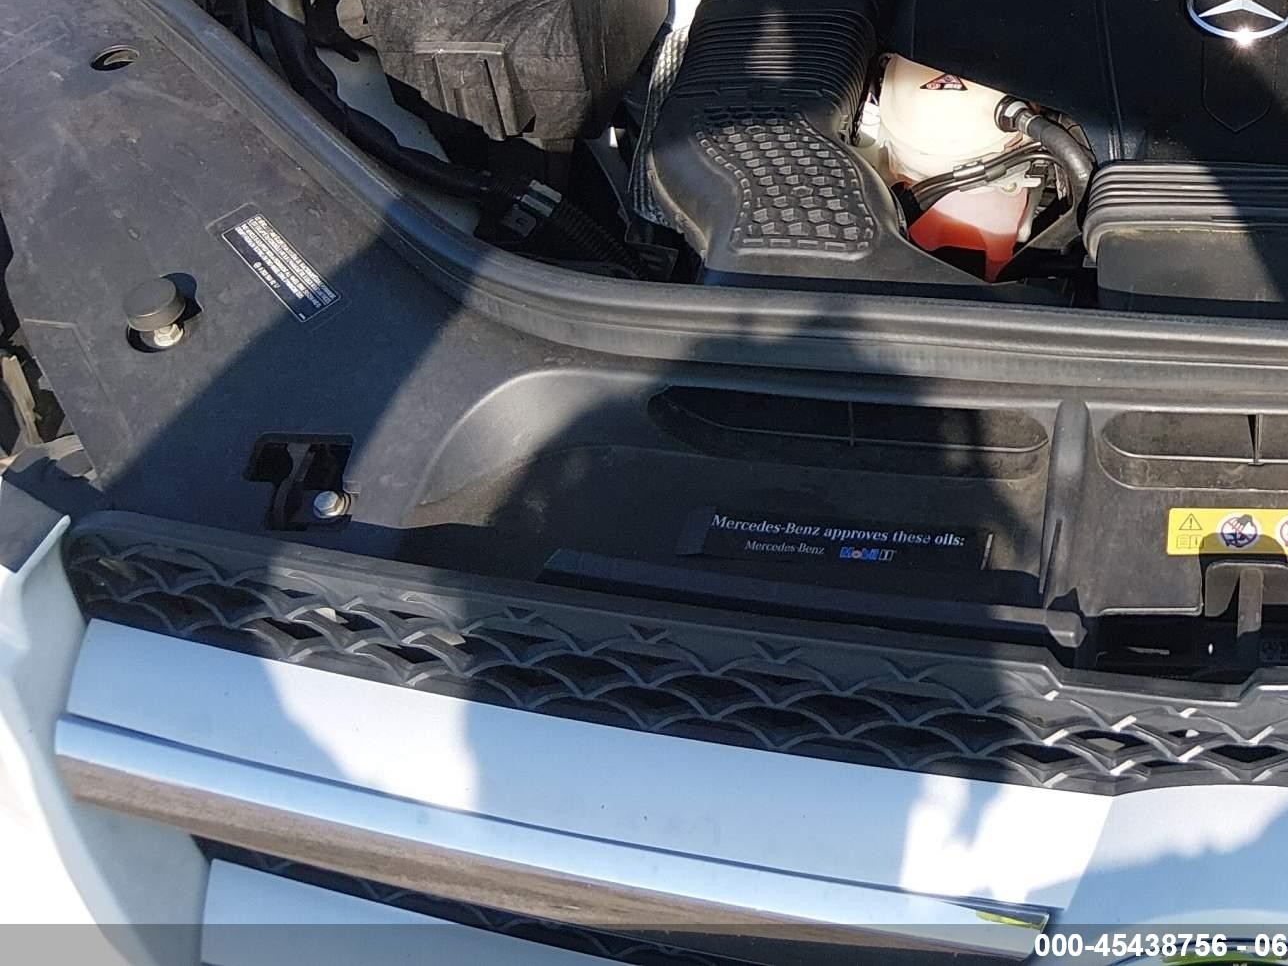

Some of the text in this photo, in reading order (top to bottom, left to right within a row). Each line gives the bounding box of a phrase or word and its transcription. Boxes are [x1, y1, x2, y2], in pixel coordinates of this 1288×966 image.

[711, 514, 965, 547] Mercedes-Benz approves these oils:
[744, 540, 825, 555] Mercedes-Benz
